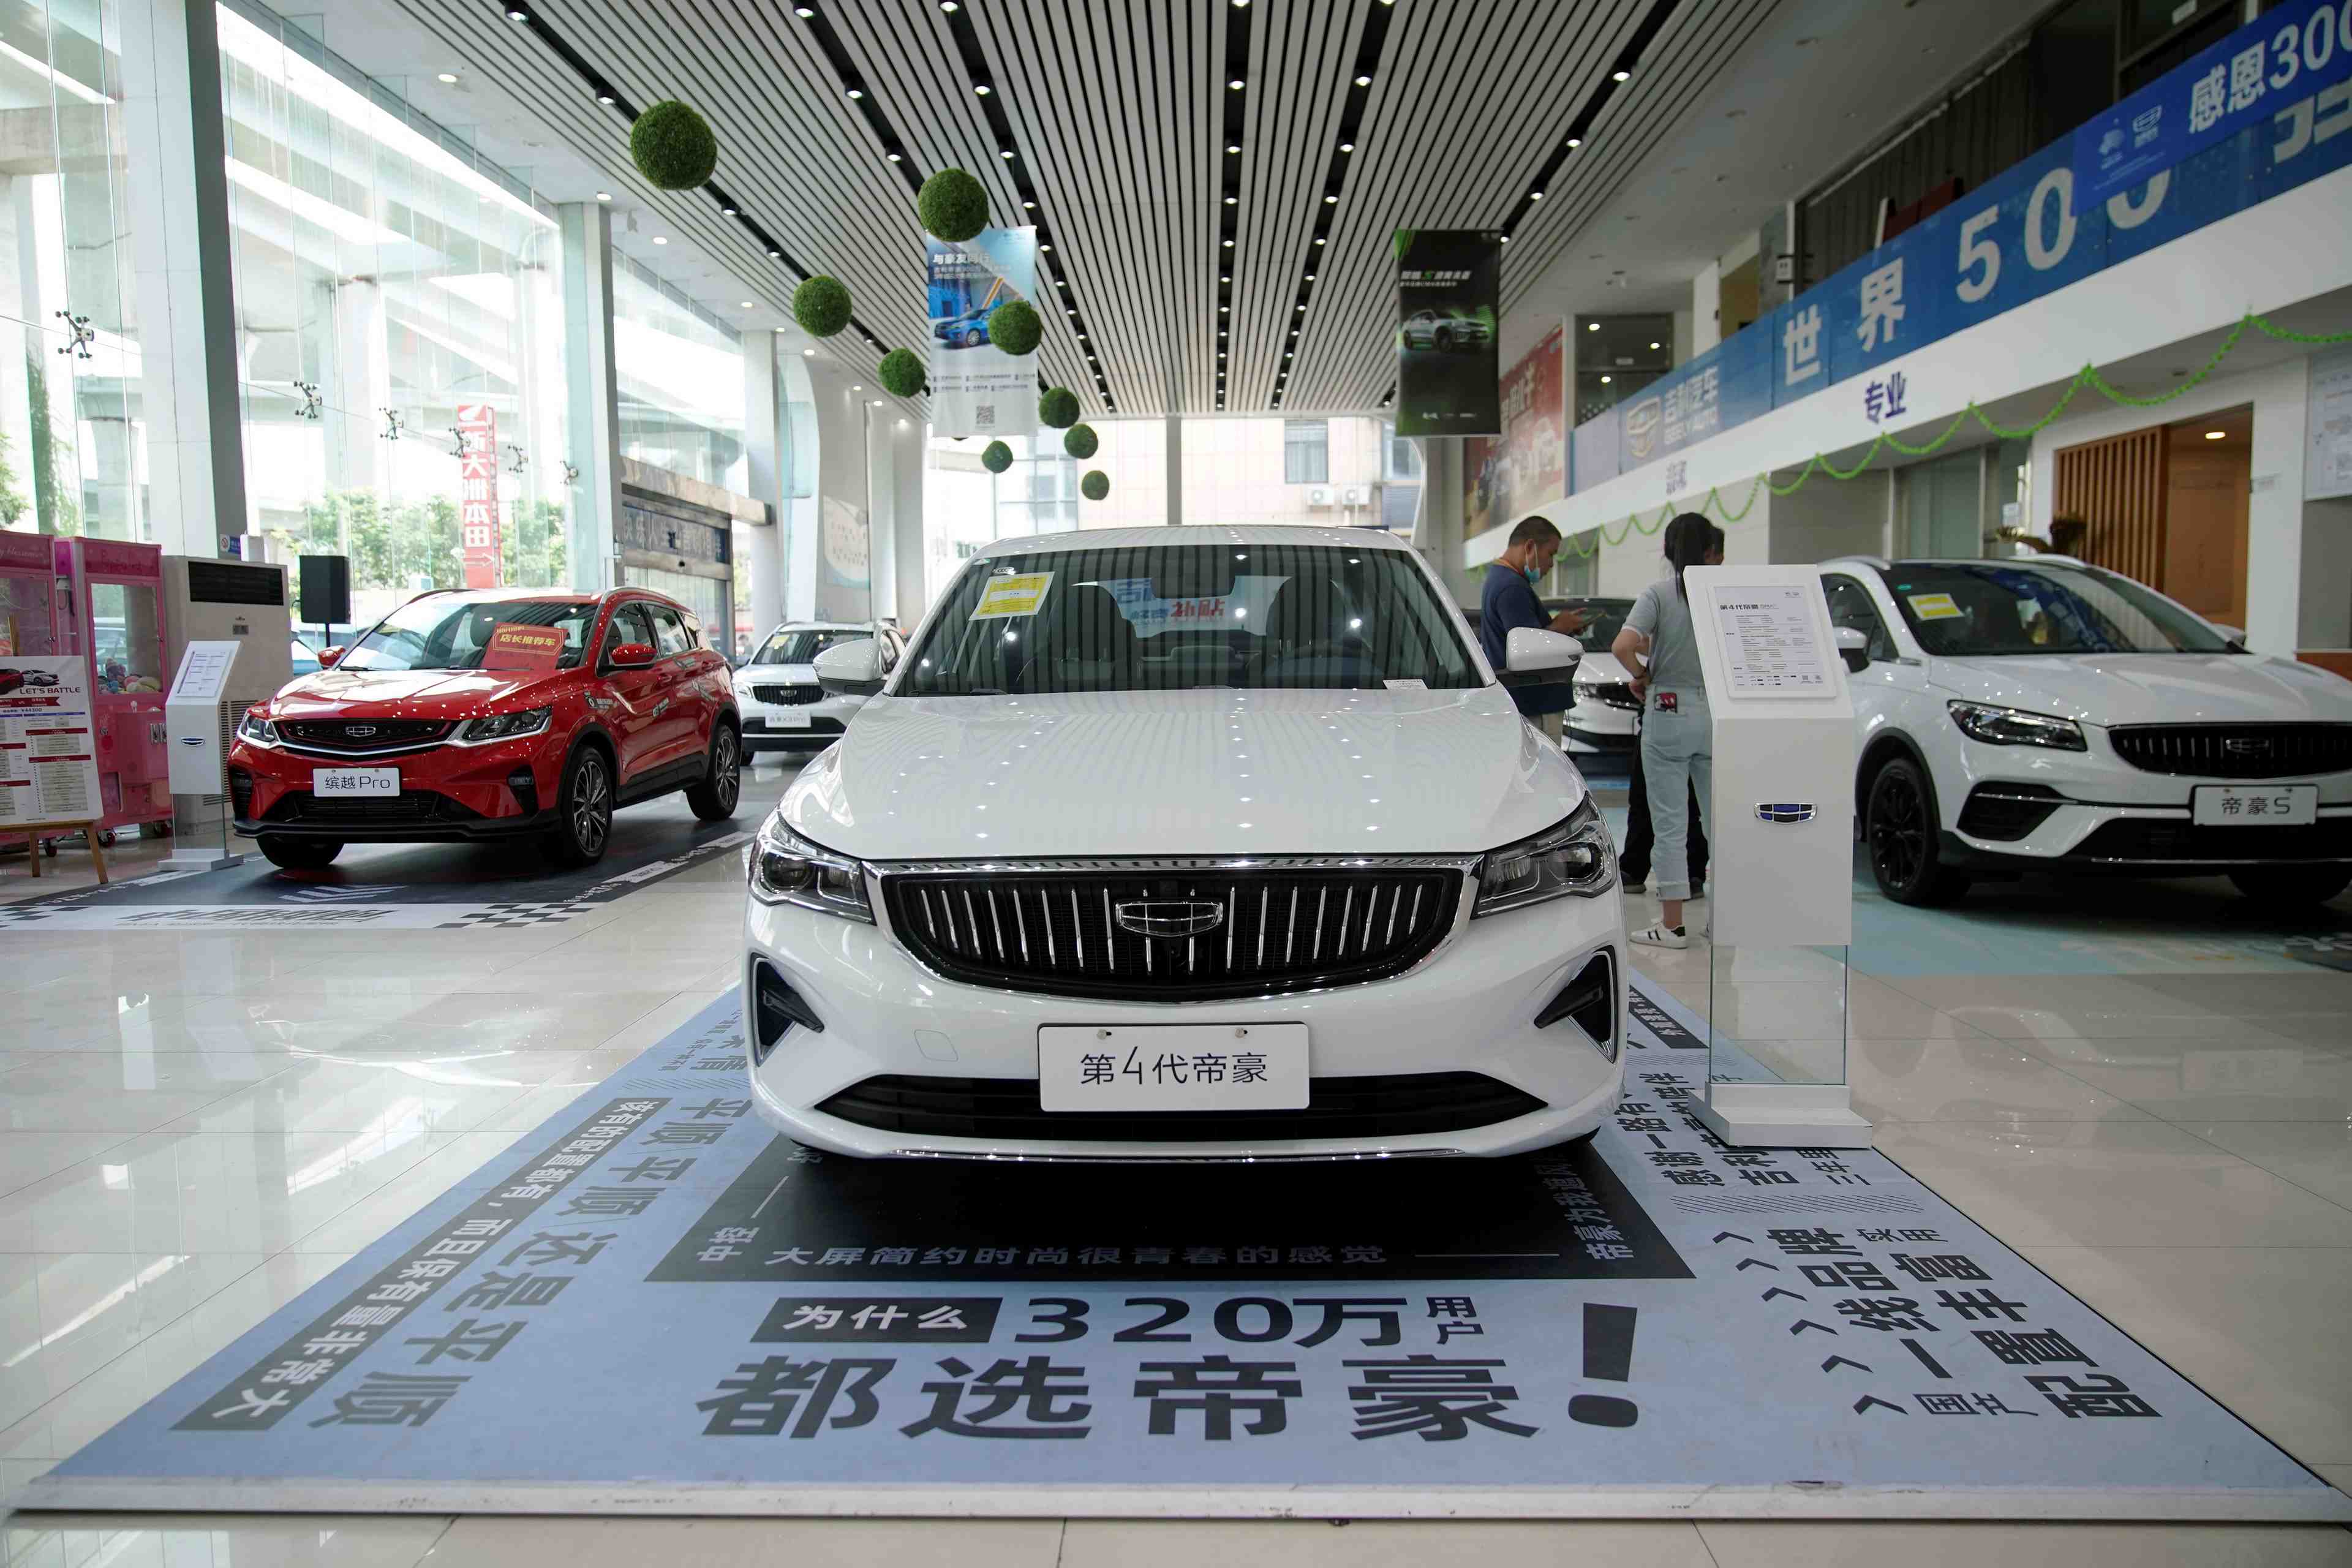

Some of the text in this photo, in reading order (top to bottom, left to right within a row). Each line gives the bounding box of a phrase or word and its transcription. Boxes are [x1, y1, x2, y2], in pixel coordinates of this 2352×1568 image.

[1864, 371, 1908, 424] 专业
[499, 633, 556, 647] 店长推荐车
[2222, 796, 2291, 816] 帝豪S
[1079, 1046, 1268, 1085] 第4代帝豪
[1614, 1093, 1725, 1186] 感谢一路有
[783, 1296, 1485, 1348] 为什么 320万 用户
